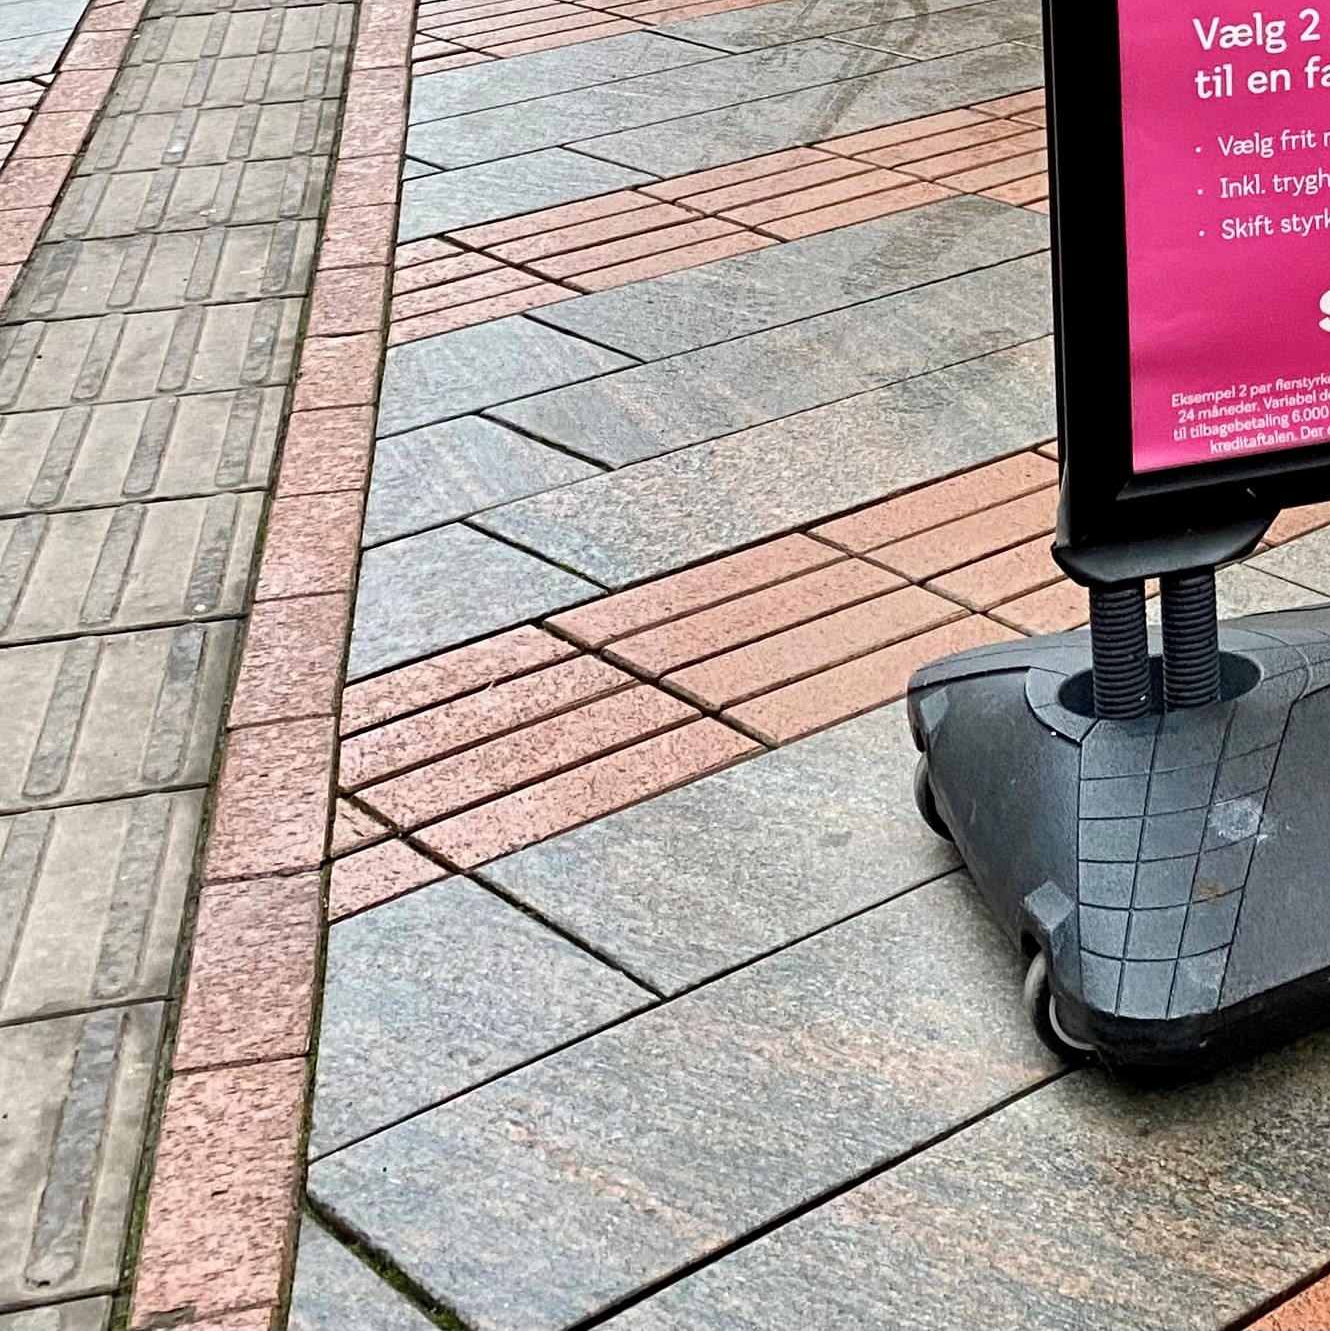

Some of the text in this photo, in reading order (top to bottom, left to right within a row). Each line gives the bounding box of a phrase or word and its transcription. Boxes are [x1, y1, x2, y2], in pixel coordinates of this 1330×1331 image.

[1193, 12, 1287, 53] Vælg
[1299, 8, 1320, 42] 2
[1195, 64, 1232, 99] til
[1247, 68, 1291, 94] en
[1218, 131, 1274, 159] Vælg
[1281, 128, 1316, 152] frit
[1220, 171, 1266, 199] Inkl.
[1221, 215, 1274, 242] Skift
[1172, 386, 1235, 407] Eksempel
[1239, 384, 1247, 396] 2
[1251, 383, 1272, 398] par
[1178, 409, 1194, 423] 24
[1198, 403, 1260, 420] måneder.
[1264, 390, 1316, 410] Variabel
[1173, 427, 1187, 441] til
[1190, 414, 1289, 438] tilbagebetaling
[1292, 406, 1329, 423] 6.000
[1210, 431, 1298, 454] kreditaftalen.
[1300, 426, 1324, 439] Der
